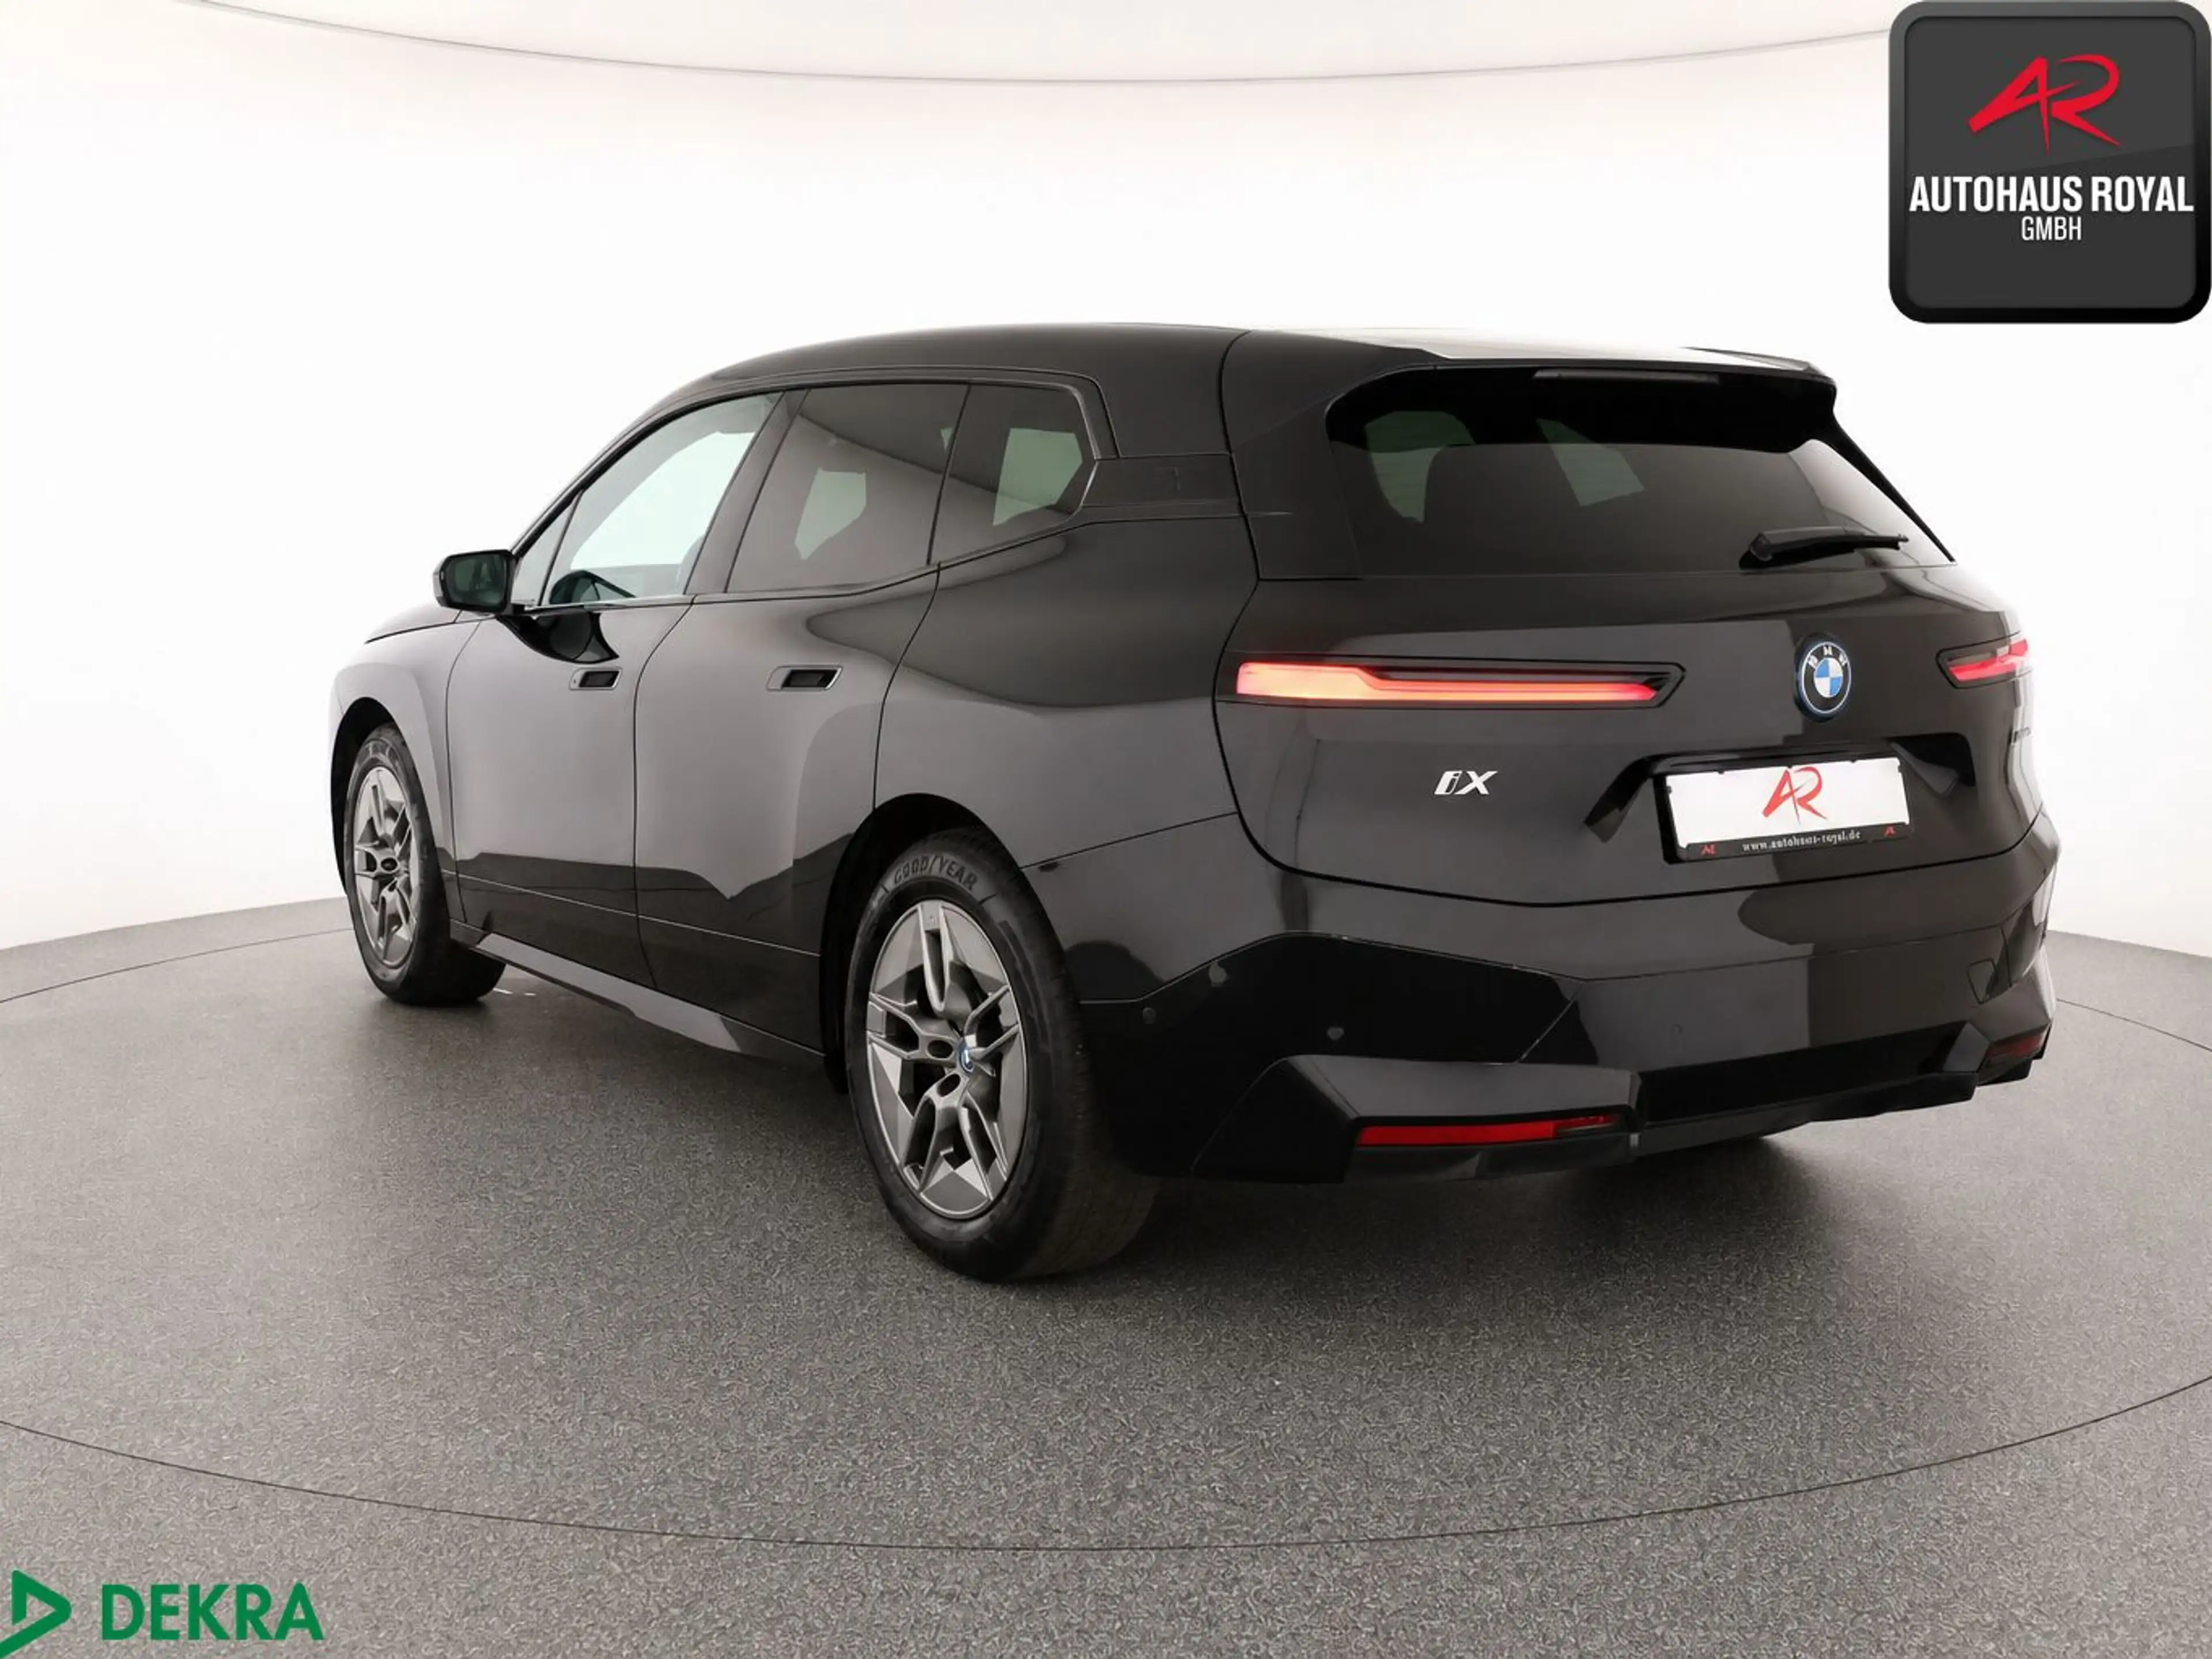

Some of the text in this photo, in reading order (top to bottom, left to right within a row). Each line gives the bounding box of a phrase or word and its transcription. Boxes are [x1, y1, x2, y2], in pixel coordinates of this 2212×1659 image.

[1808, 646, 1848, 668] BMW
[1434, 770, 1498, 795] iX
[1742, 830, 1862, 852] www.autohaus-royal.de
